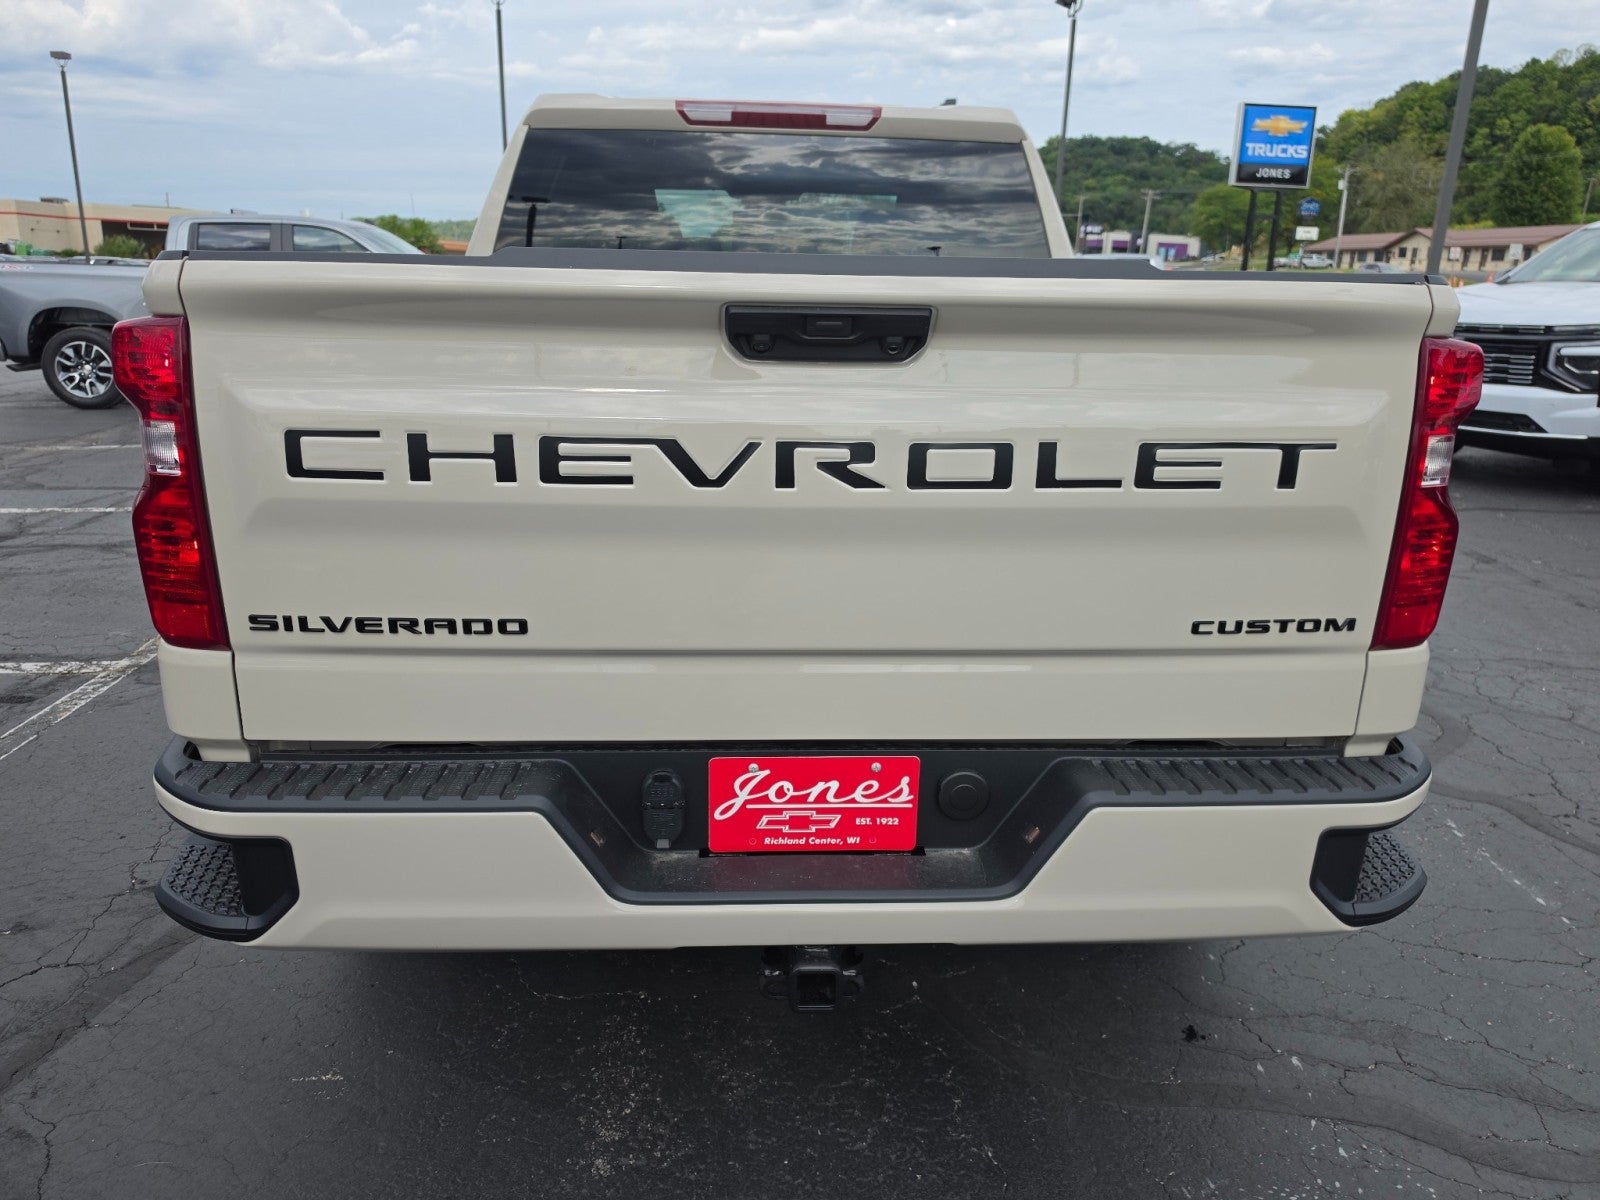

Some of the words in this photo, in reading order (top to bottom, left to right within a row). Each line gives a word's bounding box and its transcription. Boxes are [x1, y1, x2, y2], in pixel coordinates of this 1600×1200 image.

[1245, 142, 1309, 159] TRUCKS
[1255, 167, 1291, 179] JONES
[283, 429, 1337, 489] CHEVROLET
[248, 614, 529, 635] SILVERADO
[1190, 617, 1357, 635] CUSTOM
[713, 769, 914, 820] Jones
[855, 817, 873, 825] EST.
[876, 817, 899, 825] 1922
[764, 836, 806, 845] Richland
[808, 837, 843, 846] Center,
[847, 837, 860, 845] WI
